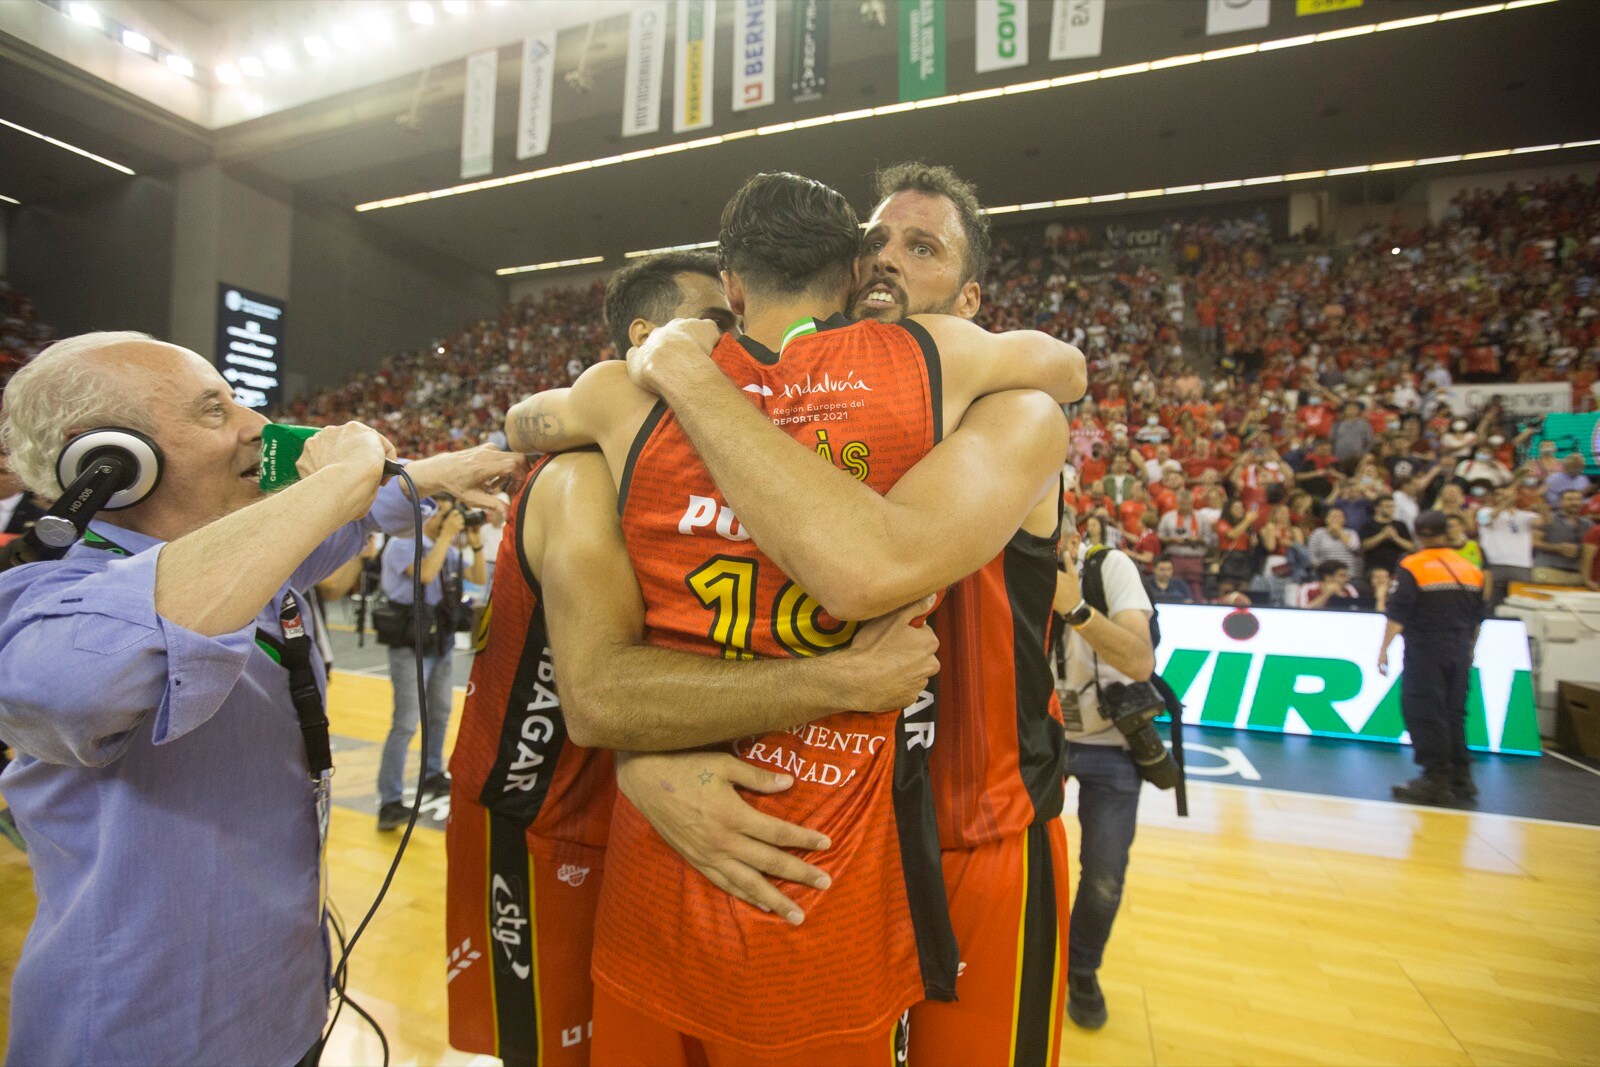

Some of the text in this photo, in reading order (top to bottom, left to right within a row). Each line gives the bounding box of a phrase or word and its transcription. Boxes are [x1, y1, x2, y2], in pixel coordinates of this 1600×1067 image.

[773, 399, 866, 416] Región Europea del
[773, 411, 848, 426] DEPORTE 2021
[69, 487, 94, 513] HD 205
